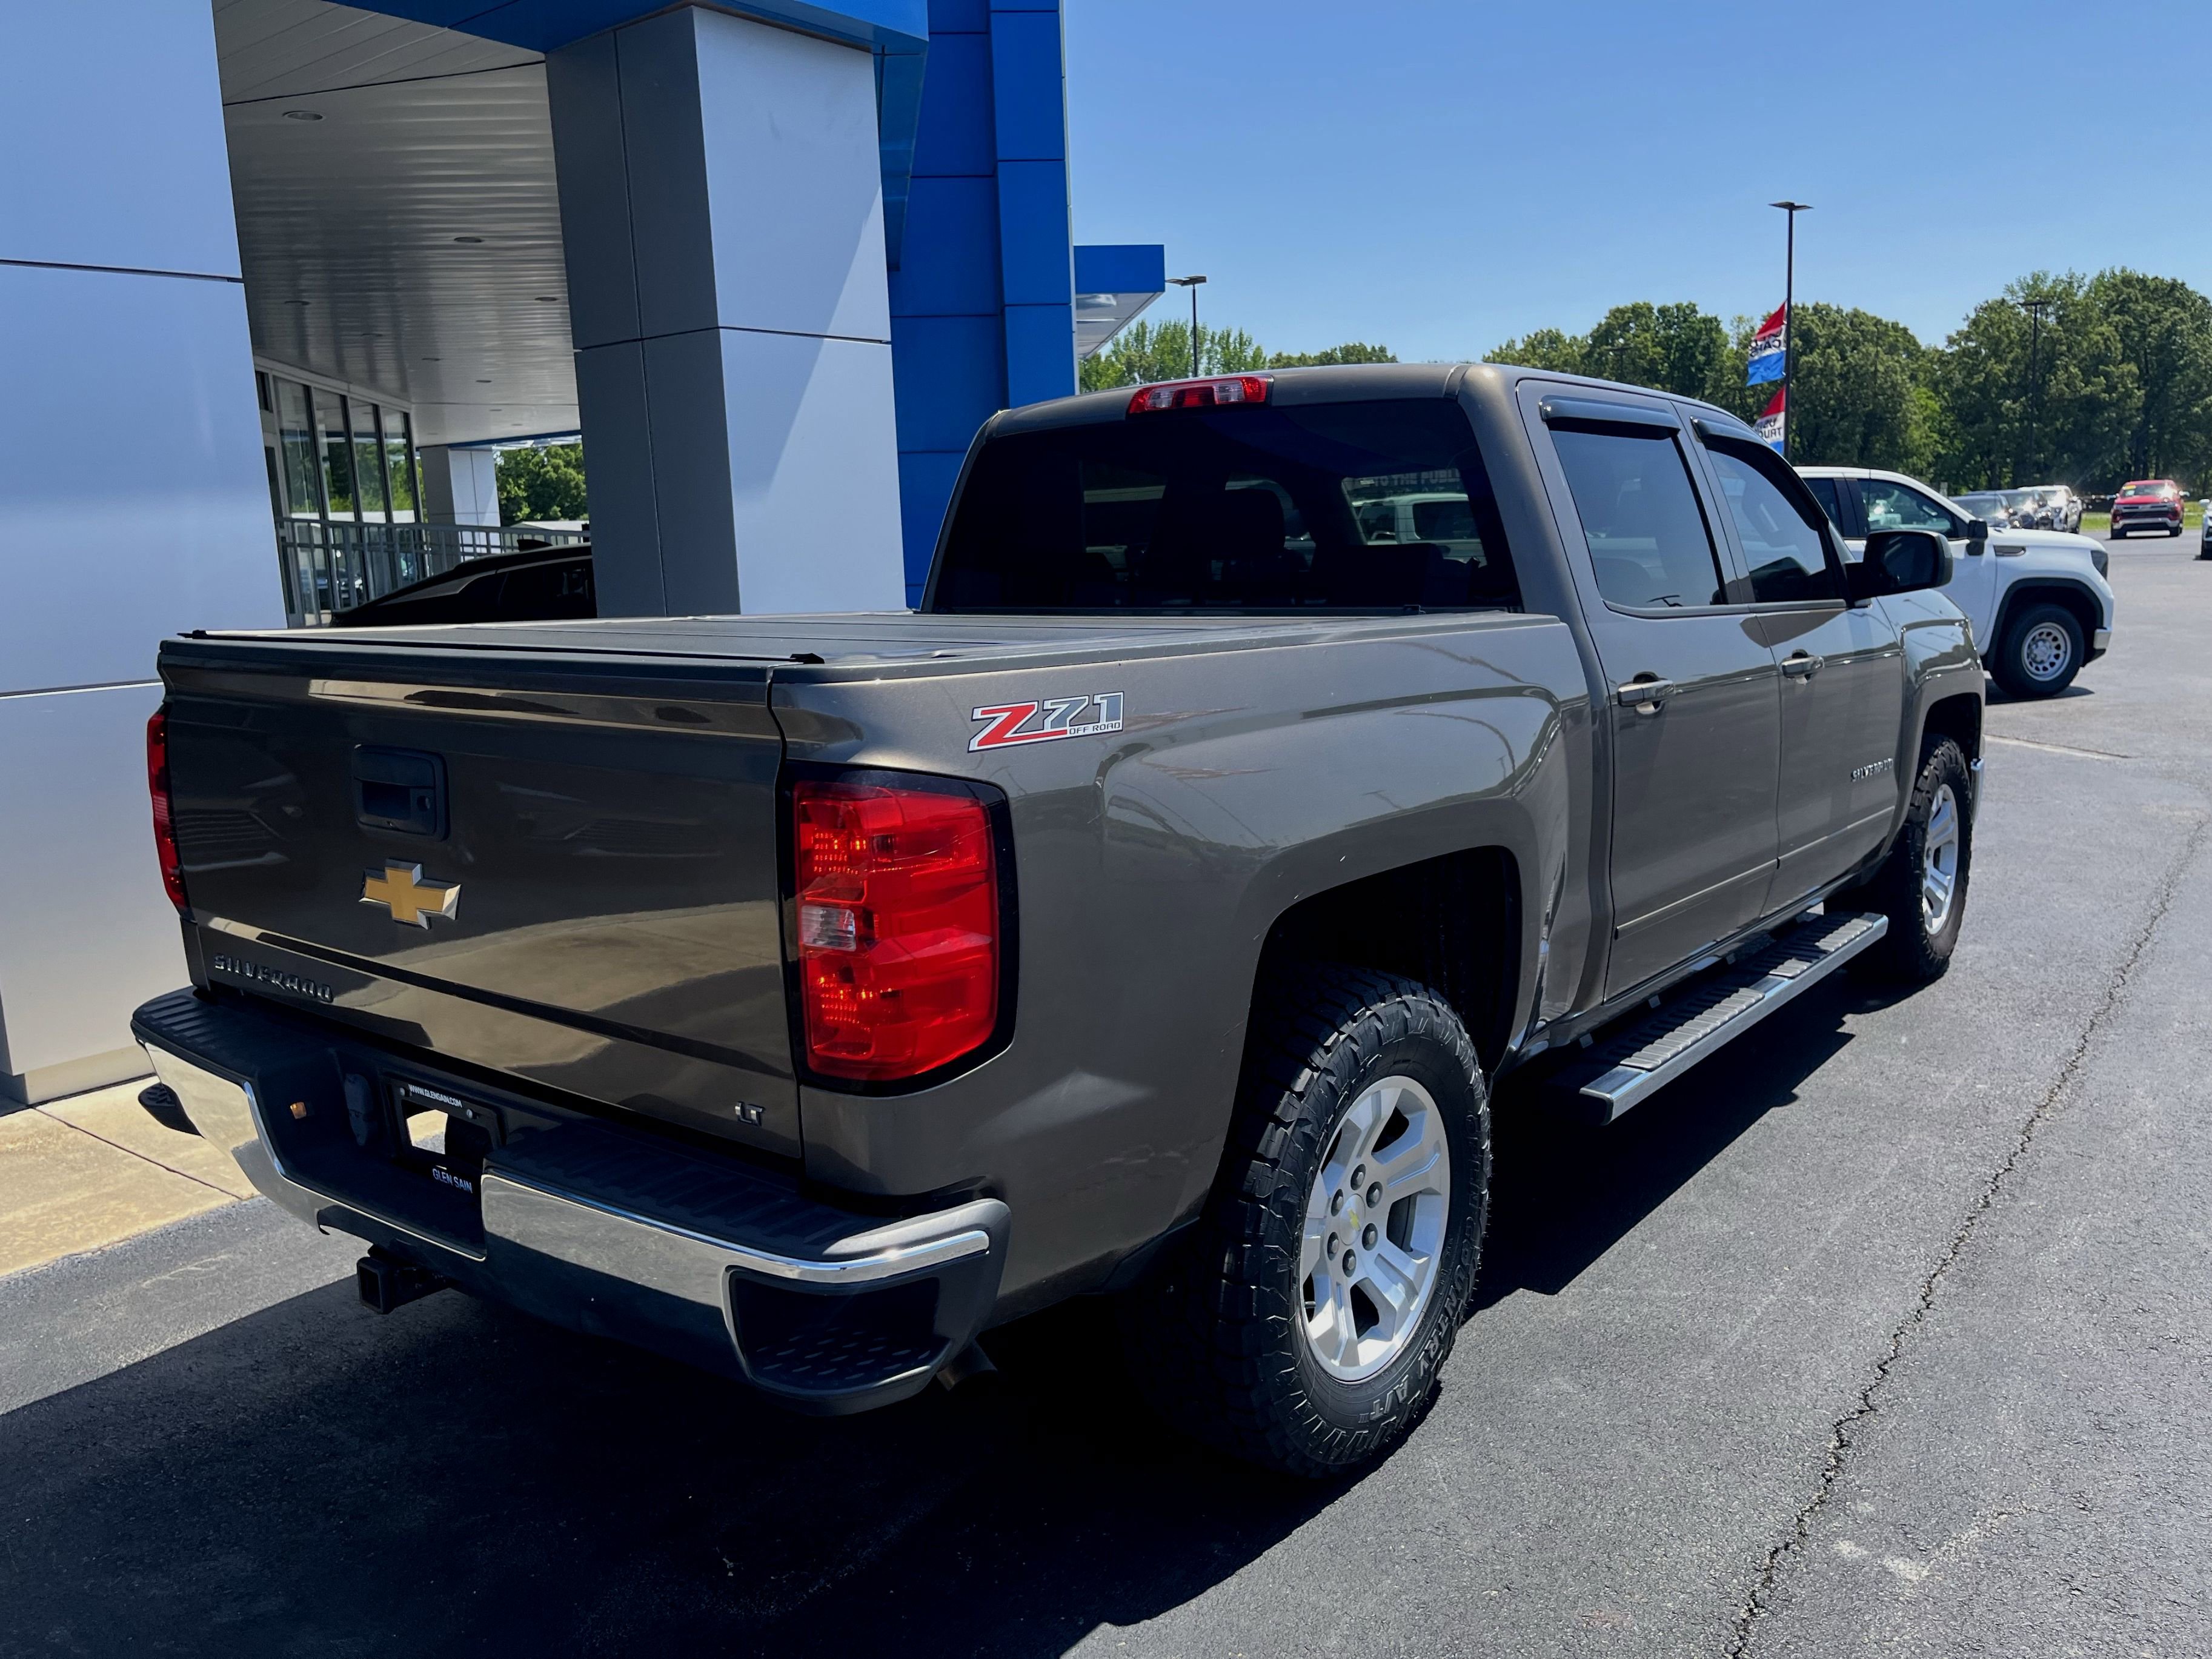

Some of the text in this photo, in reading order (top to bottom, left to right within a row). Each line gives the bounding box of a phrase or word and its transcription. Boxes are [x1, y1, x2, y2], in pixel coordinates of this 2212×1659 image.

[968, 691, 1124, 753] Z71
[1069, 722, 1121, 735] OFF ROAD
[214, 953, 333, 1003] SILVERADO
[735, 1101, 765, 1126] LT
[432, 1168, 473, 1194] GLEN SAIN
